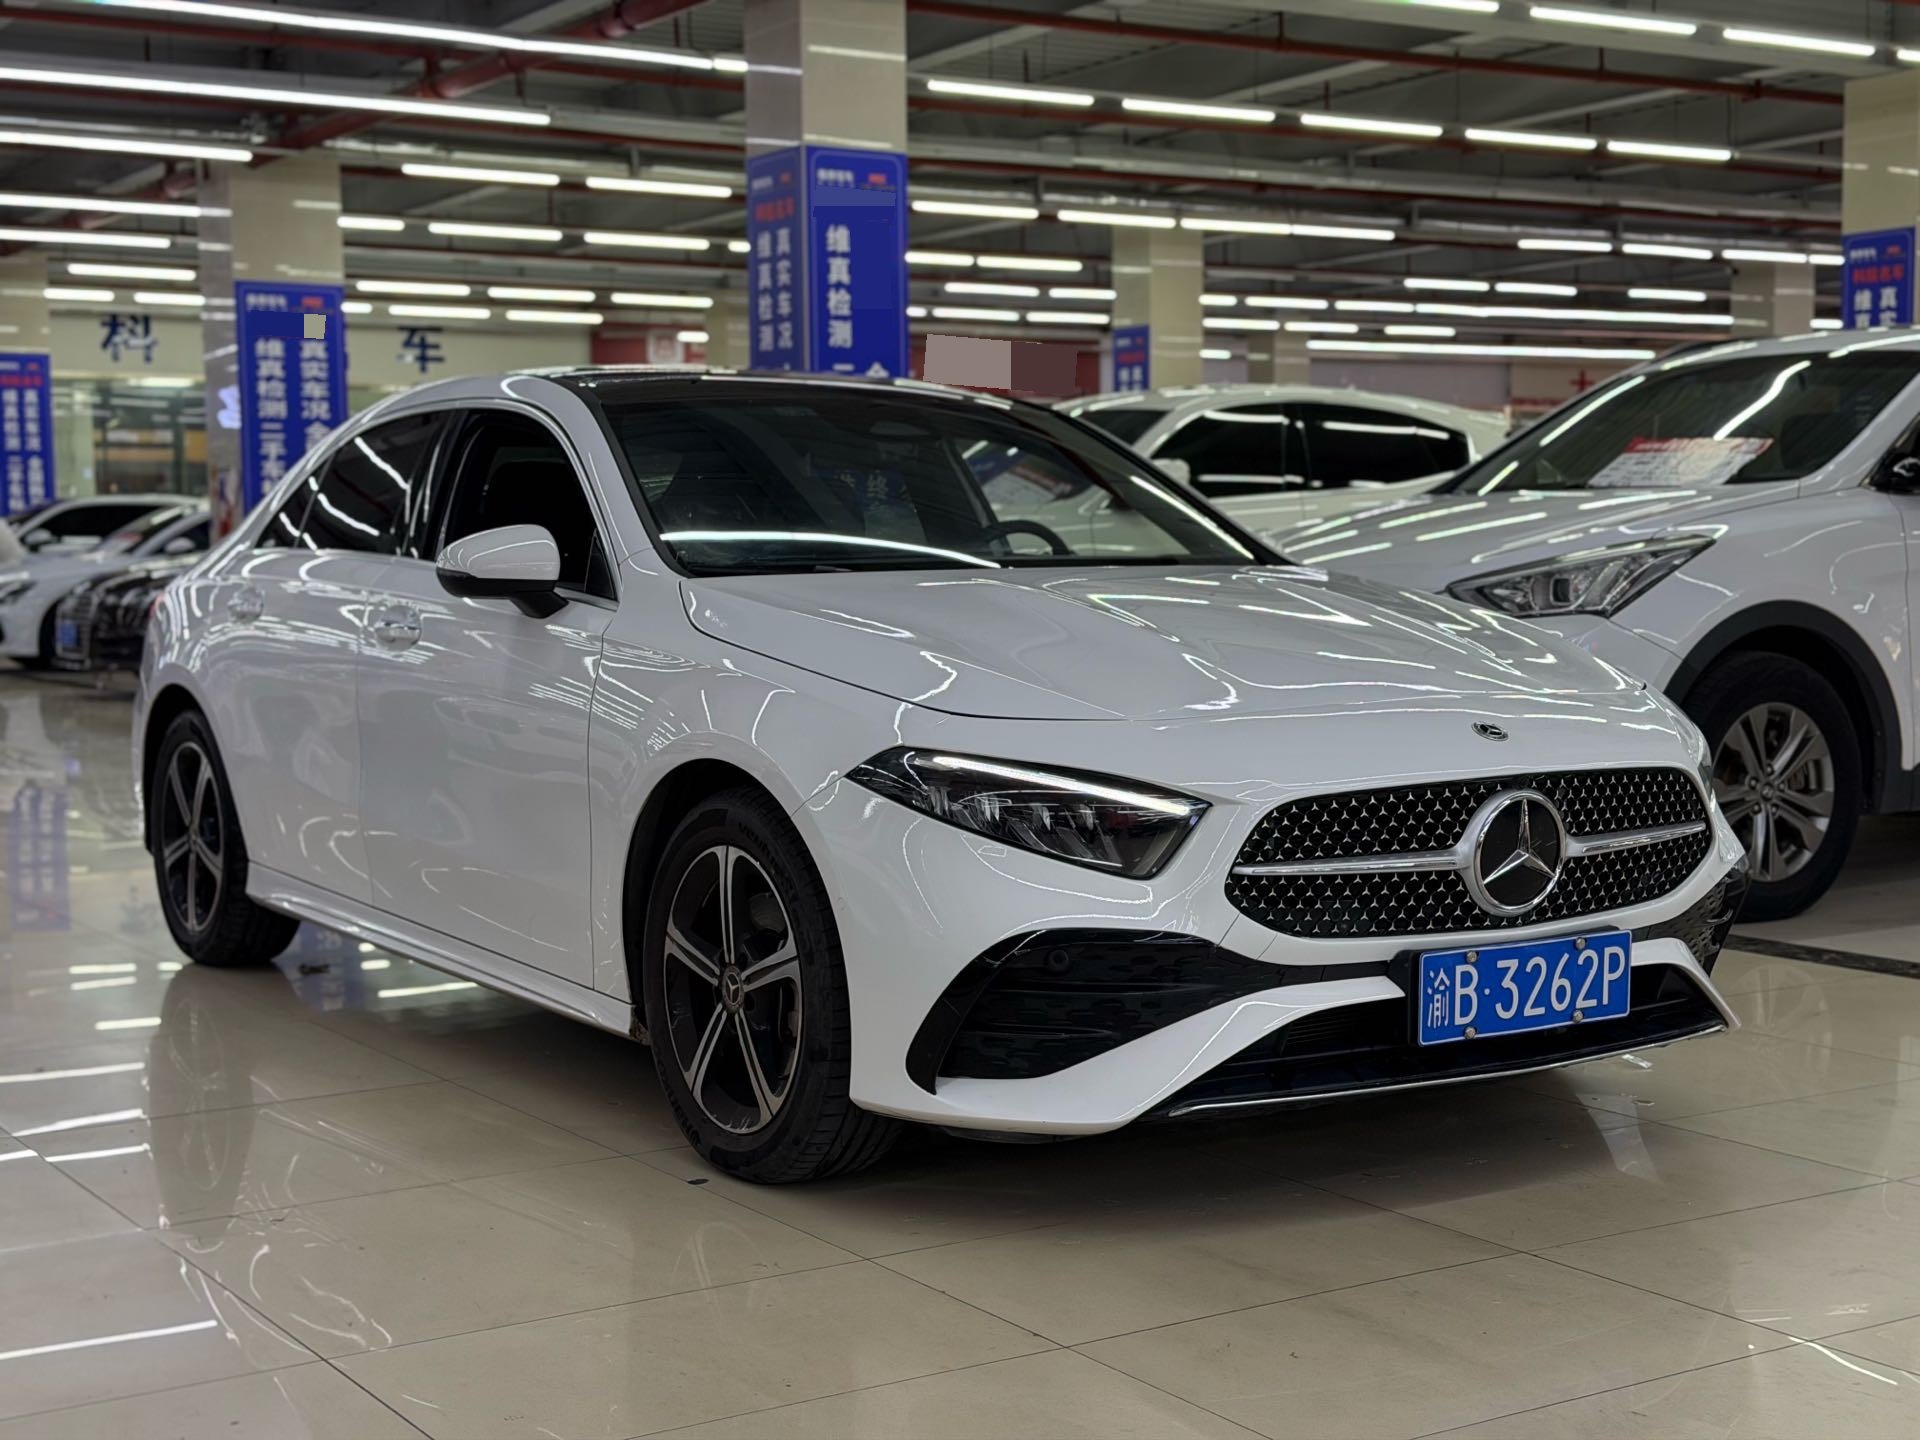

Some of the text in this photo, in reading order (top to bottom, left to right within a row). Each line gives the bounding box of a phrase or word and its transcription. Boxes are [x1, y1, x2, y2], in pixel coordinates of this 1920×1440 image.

[826, 224, 853, 349] 维真检测
[396, 325, 445, 373] 车
[1426, 945, 1627, 1029] 渝B·3262P
